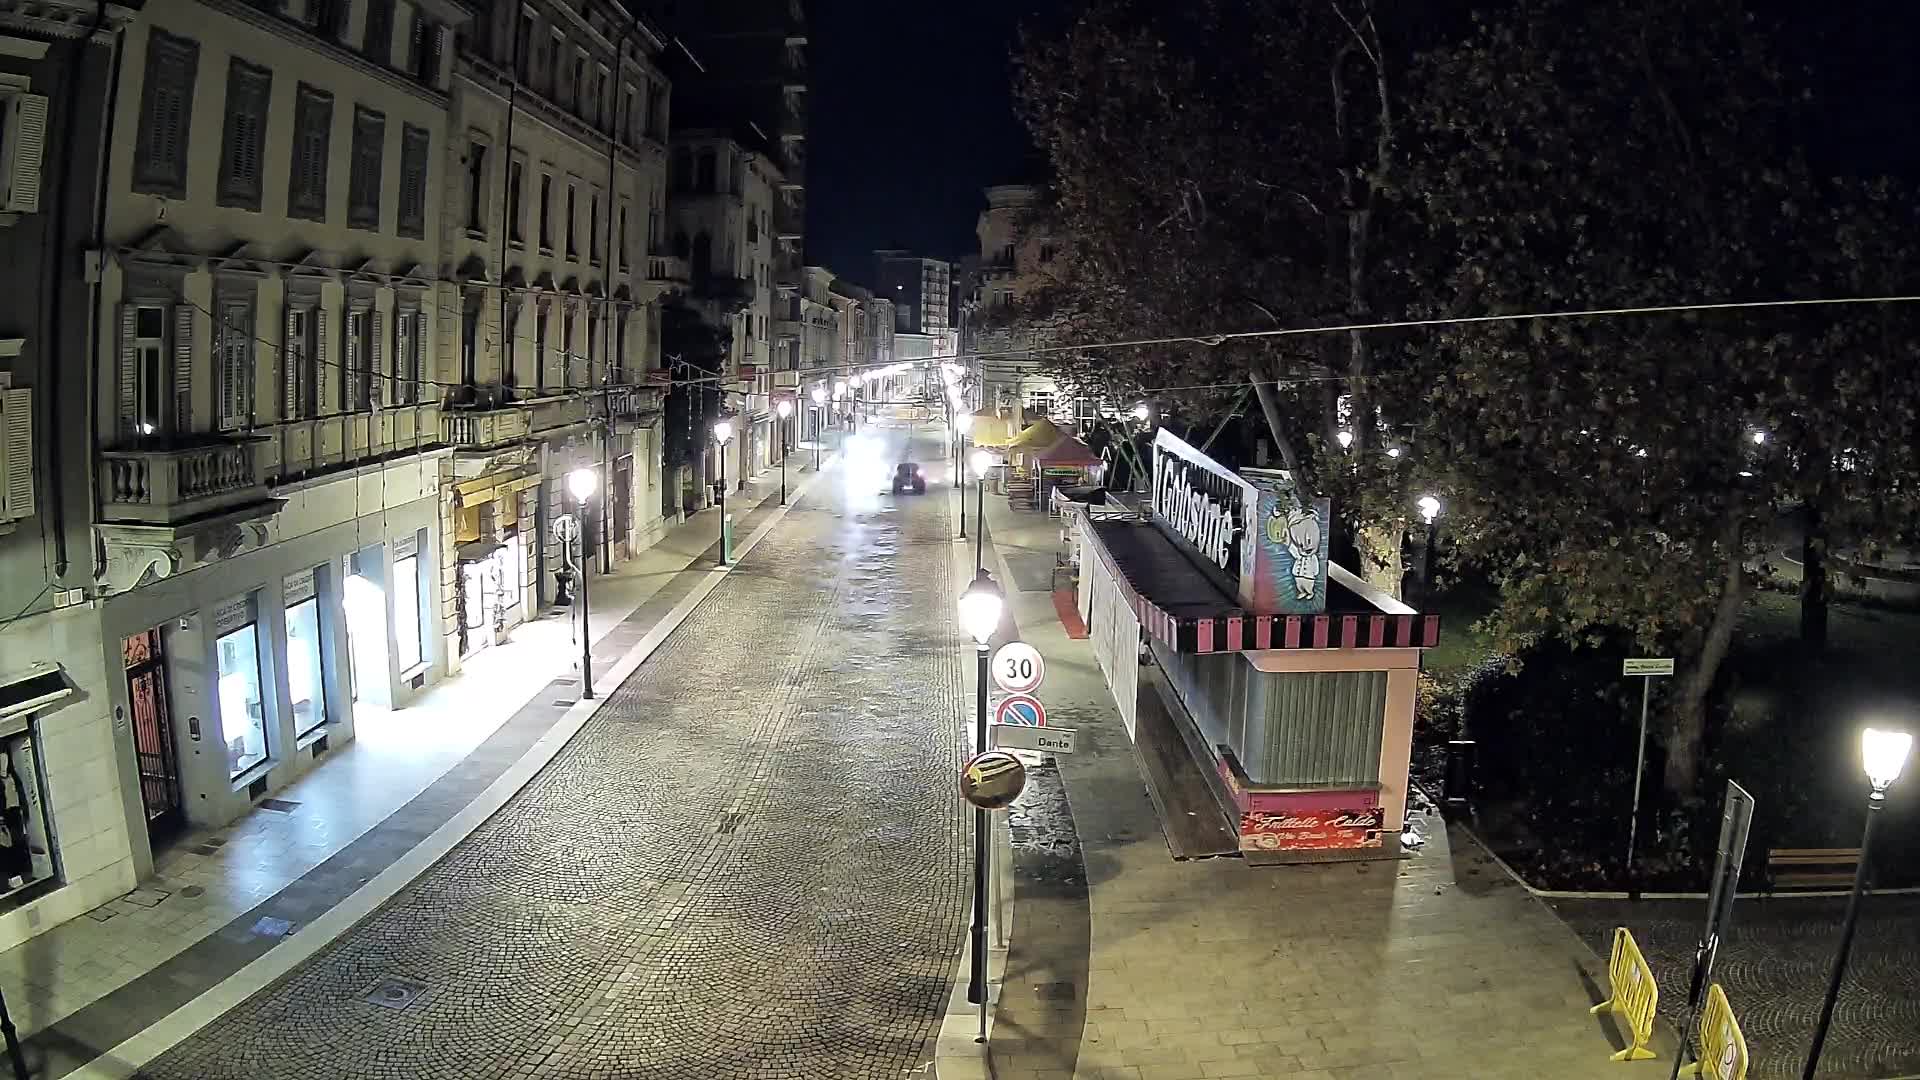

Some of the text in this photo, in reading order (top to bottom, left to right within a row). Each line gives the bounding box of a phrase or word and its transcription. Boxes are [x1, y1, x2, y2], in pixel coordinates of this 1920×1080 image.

[1163, 459, 1233, 570] Golosone
[1006, 658, 1032, 679] 30
[1038, 737, 1069, 748] Dante
